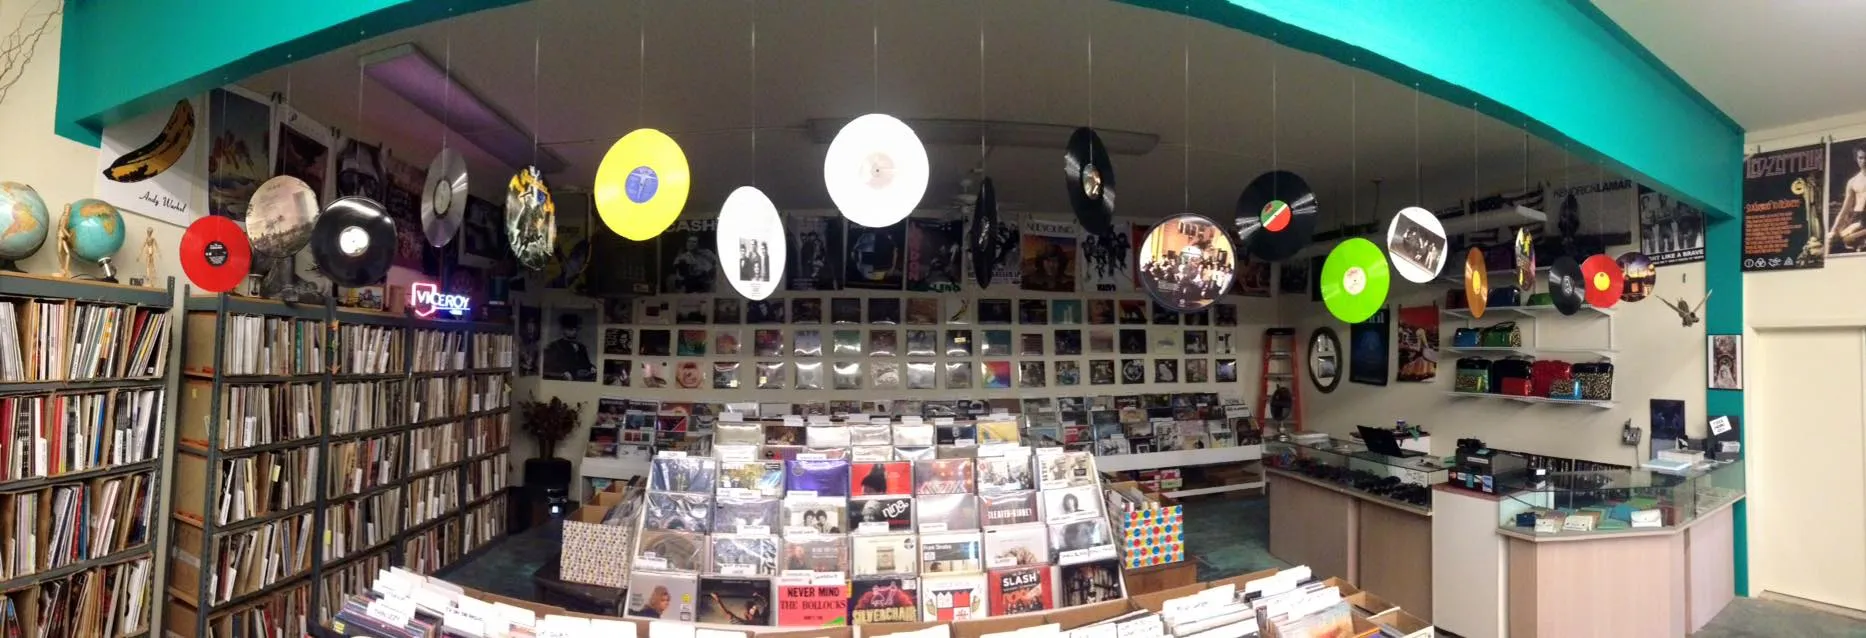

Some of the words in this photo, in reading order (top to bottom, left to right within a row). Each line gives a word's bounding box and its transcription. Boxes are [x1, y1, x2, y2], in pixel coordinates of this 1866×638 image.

[1594, 179, 1632, 193] LAMAR
[139, 191, 159, 206] Andy
[163, 196, 187, 213] Warhol
[1683, 249, 1704, 257] BRAVE
[416, 290, 471, 309] VICEROY
[1003, 574, 1037, 588] SLASH
[787, 587, 816, 598] NEVER
[818, 587, 840, 597] MIND
[780, 600, 798, 609] THE
[802, 599, 846, 610] BOLLOCKS
[852, 606, 917, 624] SILVERCHAIR
